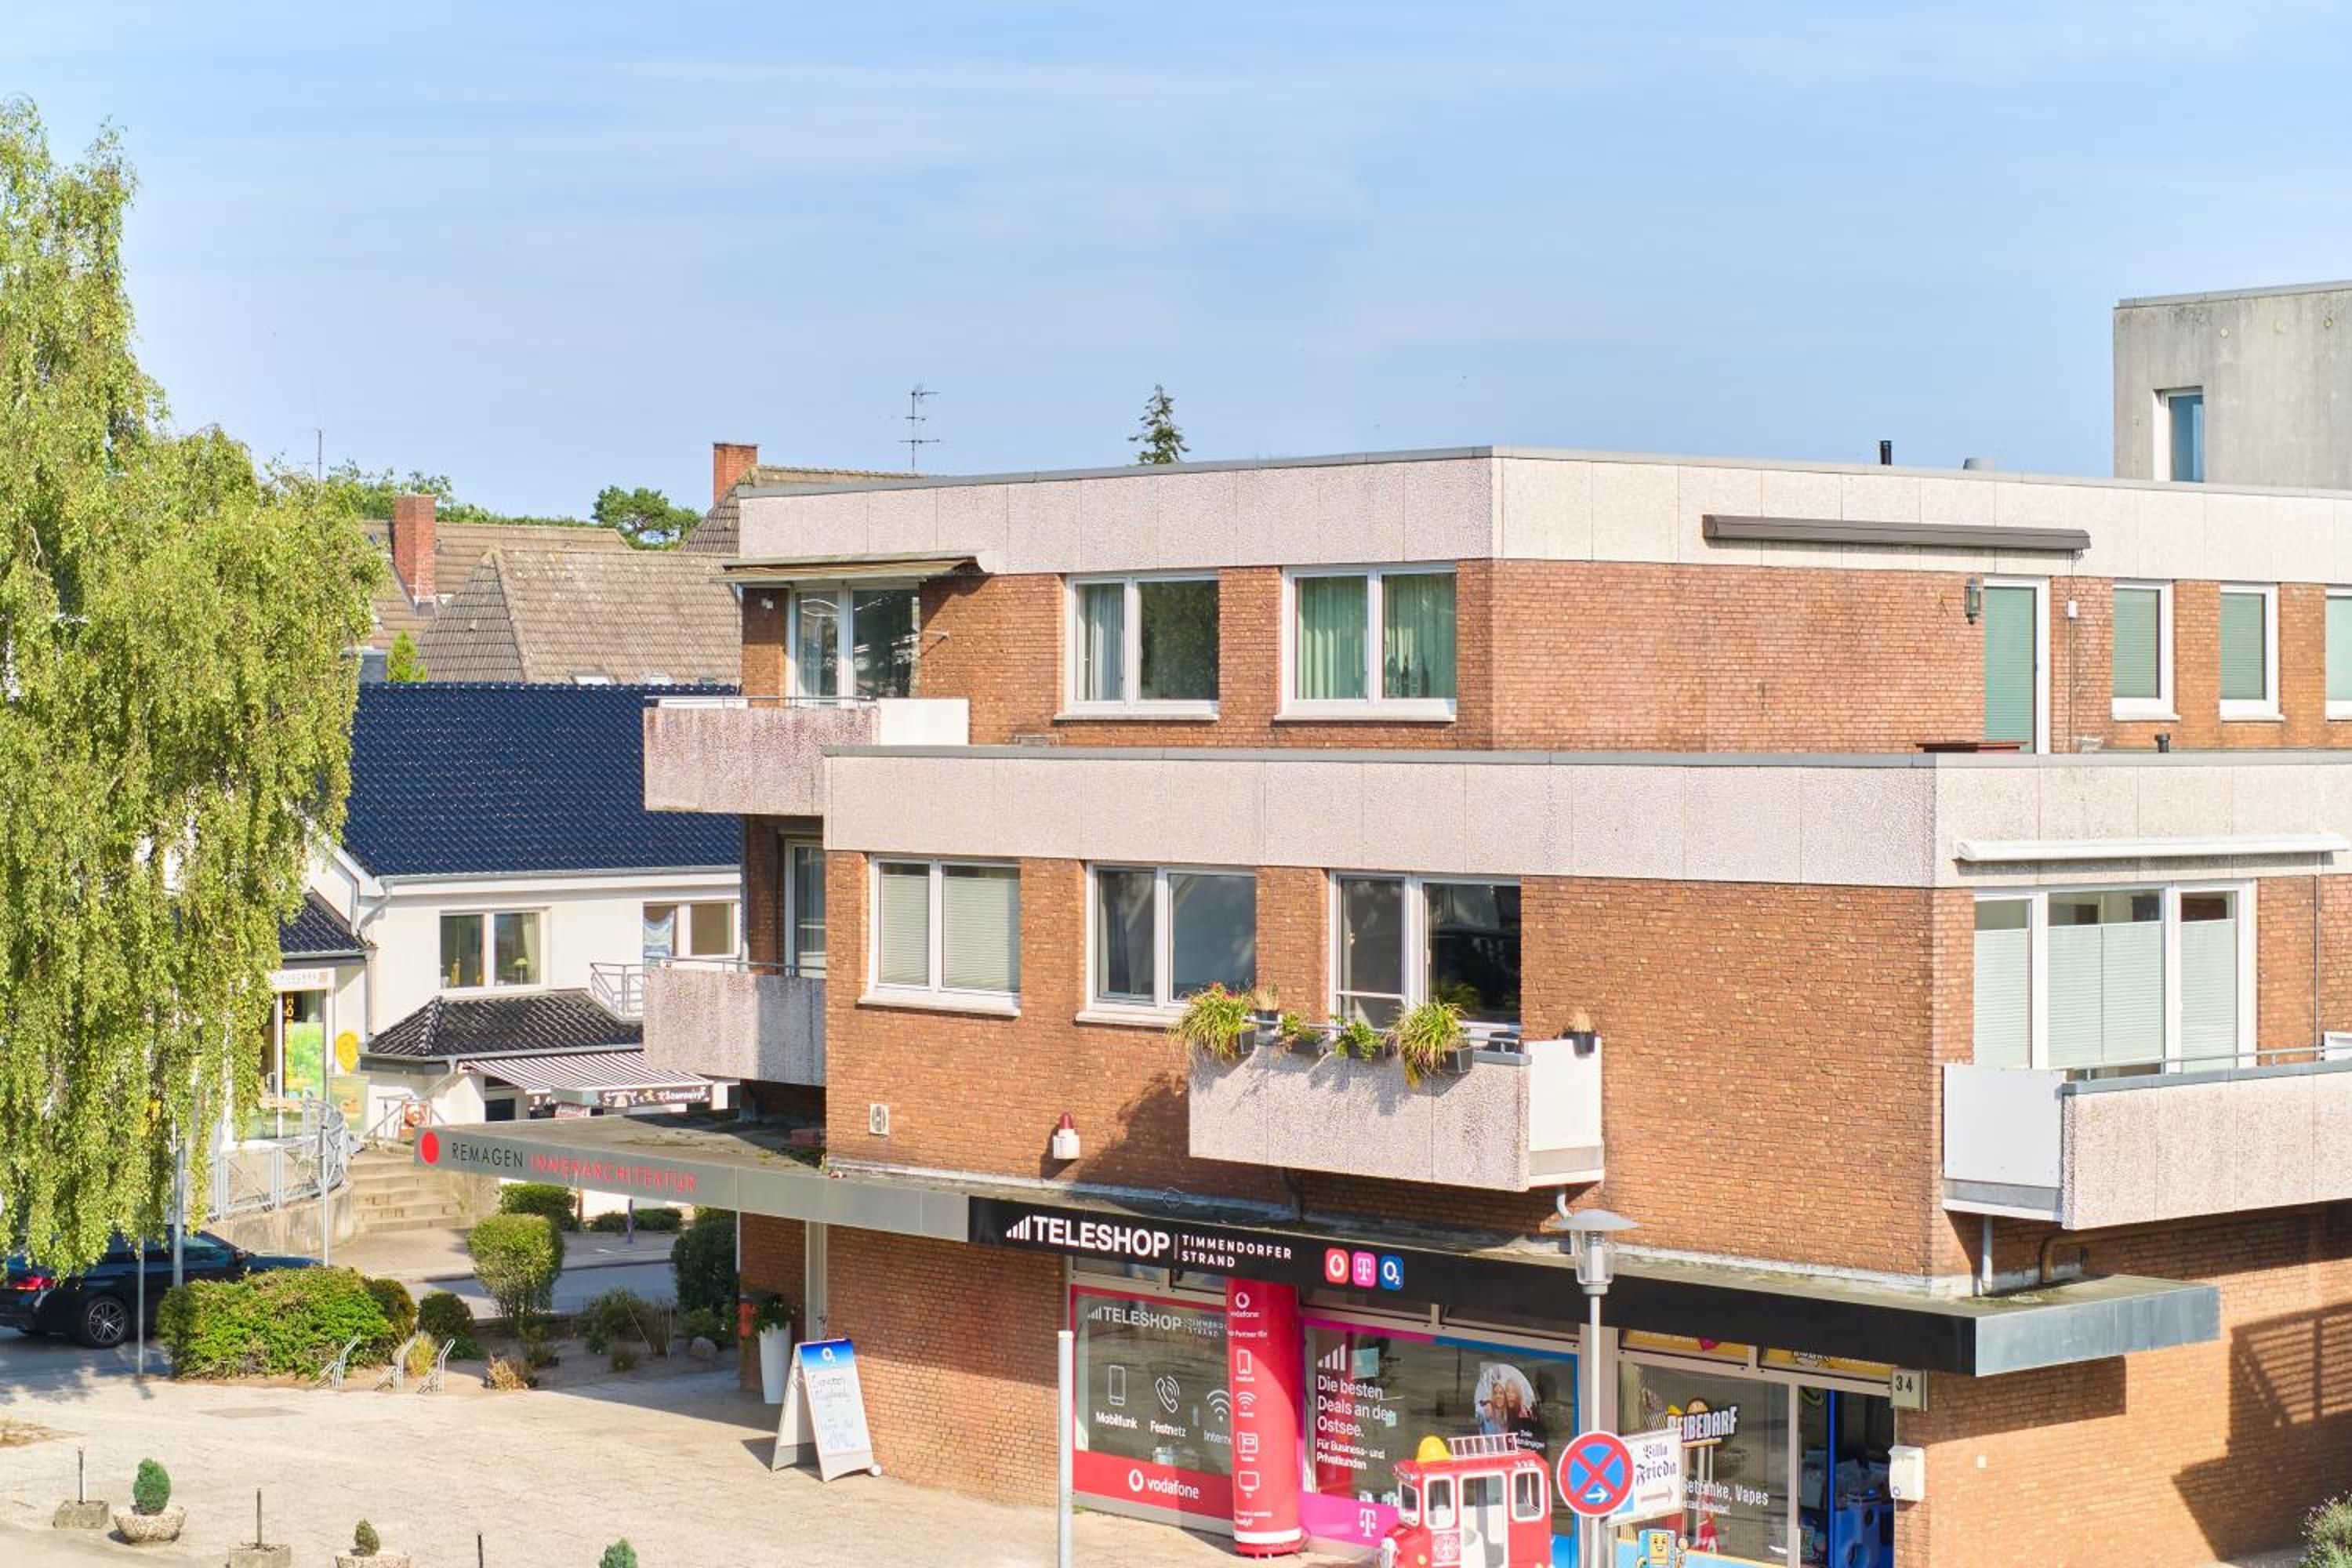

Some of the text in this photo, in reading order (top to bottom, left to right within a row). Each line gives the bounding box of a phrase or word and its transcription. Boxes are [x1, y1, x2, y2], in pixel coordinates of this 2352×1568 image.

[451, 1142, 698, 1192] REMAGEN INNENARCHITEKTUR
[1033, 1215, 1171, 1258] TELESHOP
[1182, 1235, 1291, 1259] TIMMENDORFER
[1181, 1250, 1235, 1268] STRAND
[1104, 1306, 1181, 1330] TELESHOP
[1318, 1375, 1382, 1400] Die besten
[1895, 1374, 1913, 1393] 34
[1318, 1396, 1352, 1415] Deals
[1355, 1405, 1369, 1418] an
[1096, 1412, 1138, 1429] Mobilfunk
[1150, 1420, 1185, 1437] Festnetz
[1317, 1416, 1365, 1437] Ostsee.
[1317, 1438, 1330, 1450] Für
[1370, 1447, 1385, 1459] und
[1317, 1451, 1367, 1470] Privatkunden
[1635, 1461, 1676, 1486] Frieda
[1147, 1477, 1200, 1499] vodafone
[1735, 1484, 1769, 1505] Vapes
